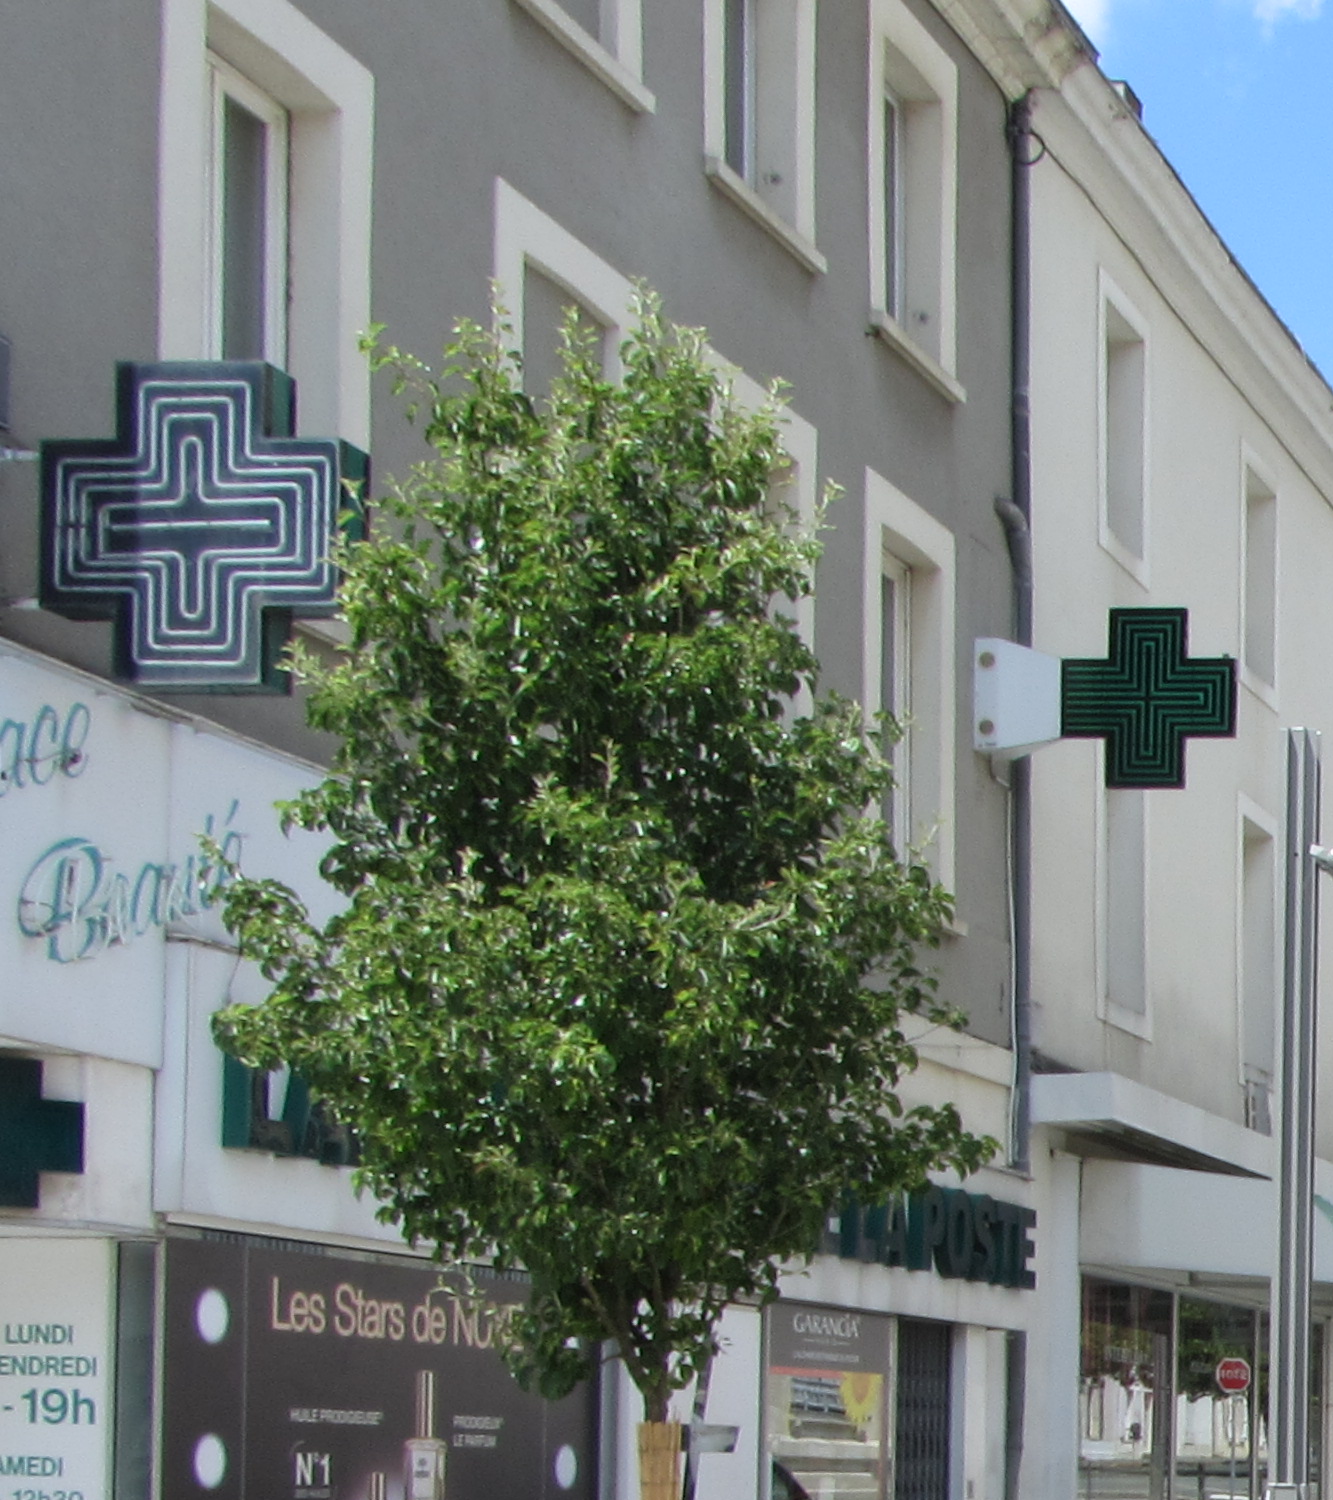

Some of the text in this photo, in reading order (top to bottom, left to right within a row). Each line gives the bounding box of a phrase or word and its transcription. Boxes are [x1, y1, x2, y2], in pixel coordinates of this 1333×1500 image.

[909, 1178, 1038, 1290] POSTE
[5, 1325, 73, 1345] LUNDI
[272, 1276, 326, 1334] Les
[334, 1282, 405, 1341] Stars
[412, 1290, 447, 1344] de
[20, 1388, 96, 1425] 19h
